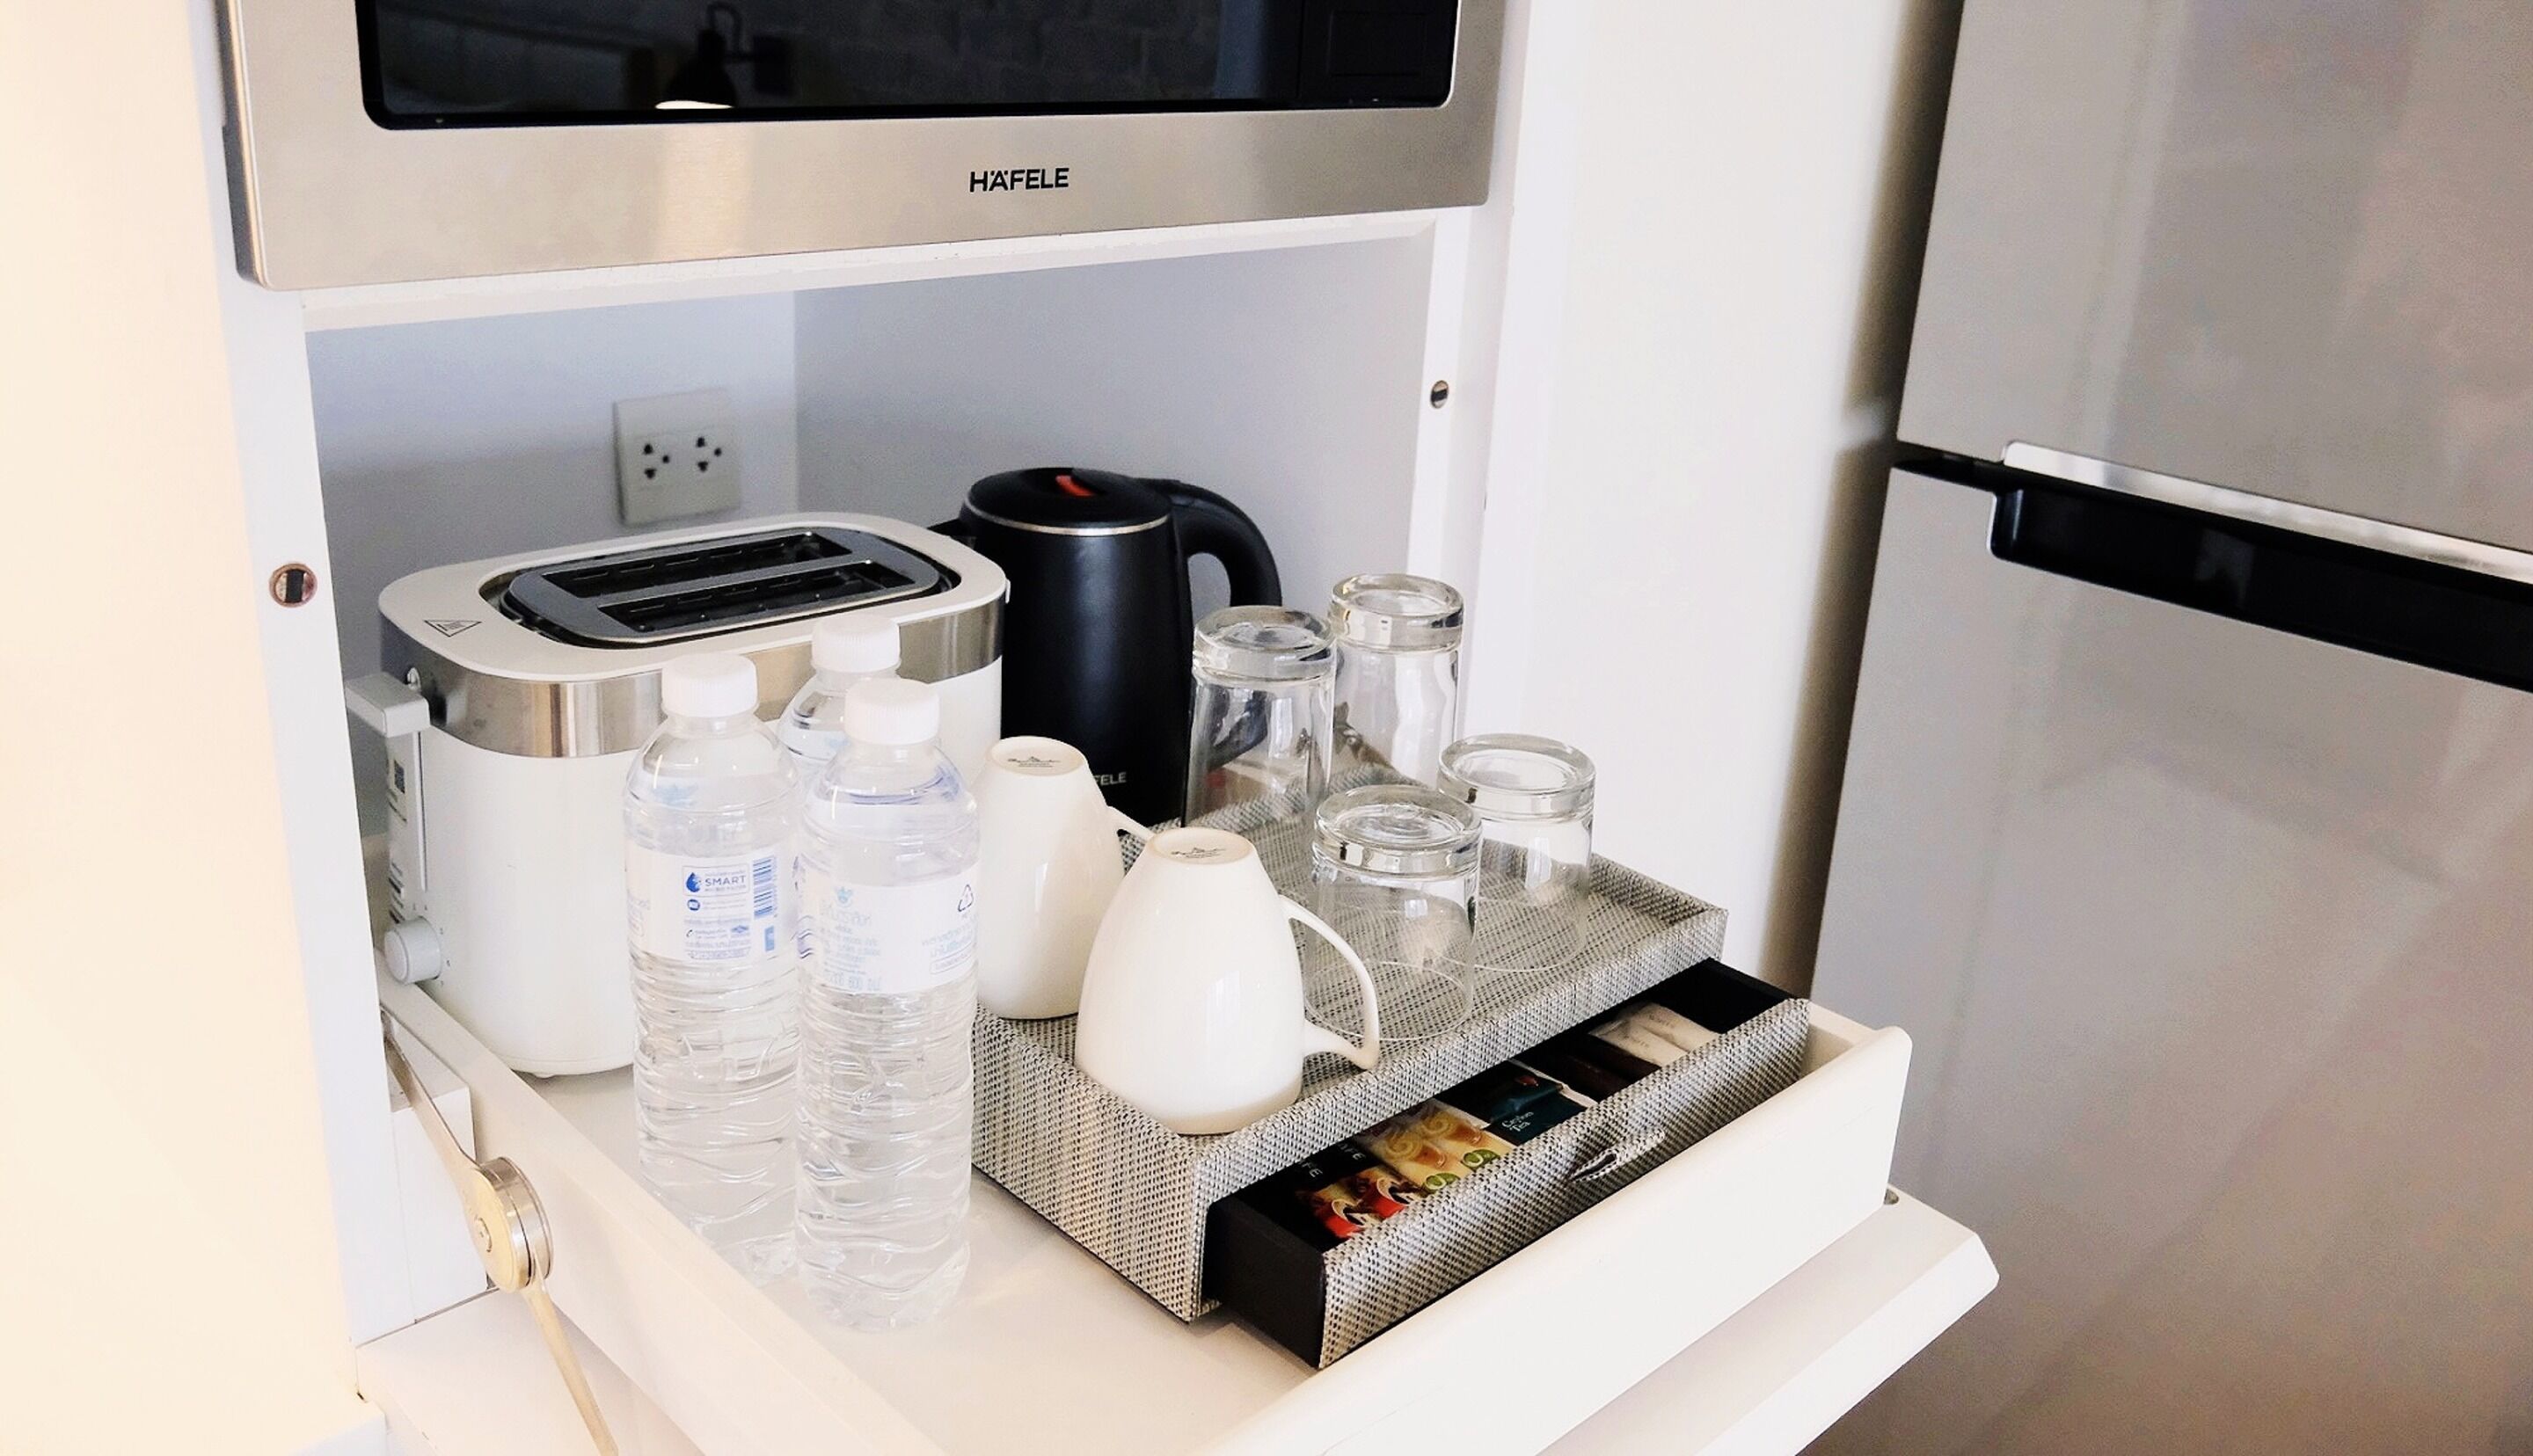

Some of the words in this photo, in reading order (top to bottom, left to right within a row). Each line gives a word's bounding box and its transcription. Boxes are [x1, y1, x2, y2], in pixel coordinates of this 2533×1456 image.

[970, 168, 1069, 193] HÄFELE
[704, 875, 746, 887] SMART
[1509, 1121, 1531, 1132] Tea
